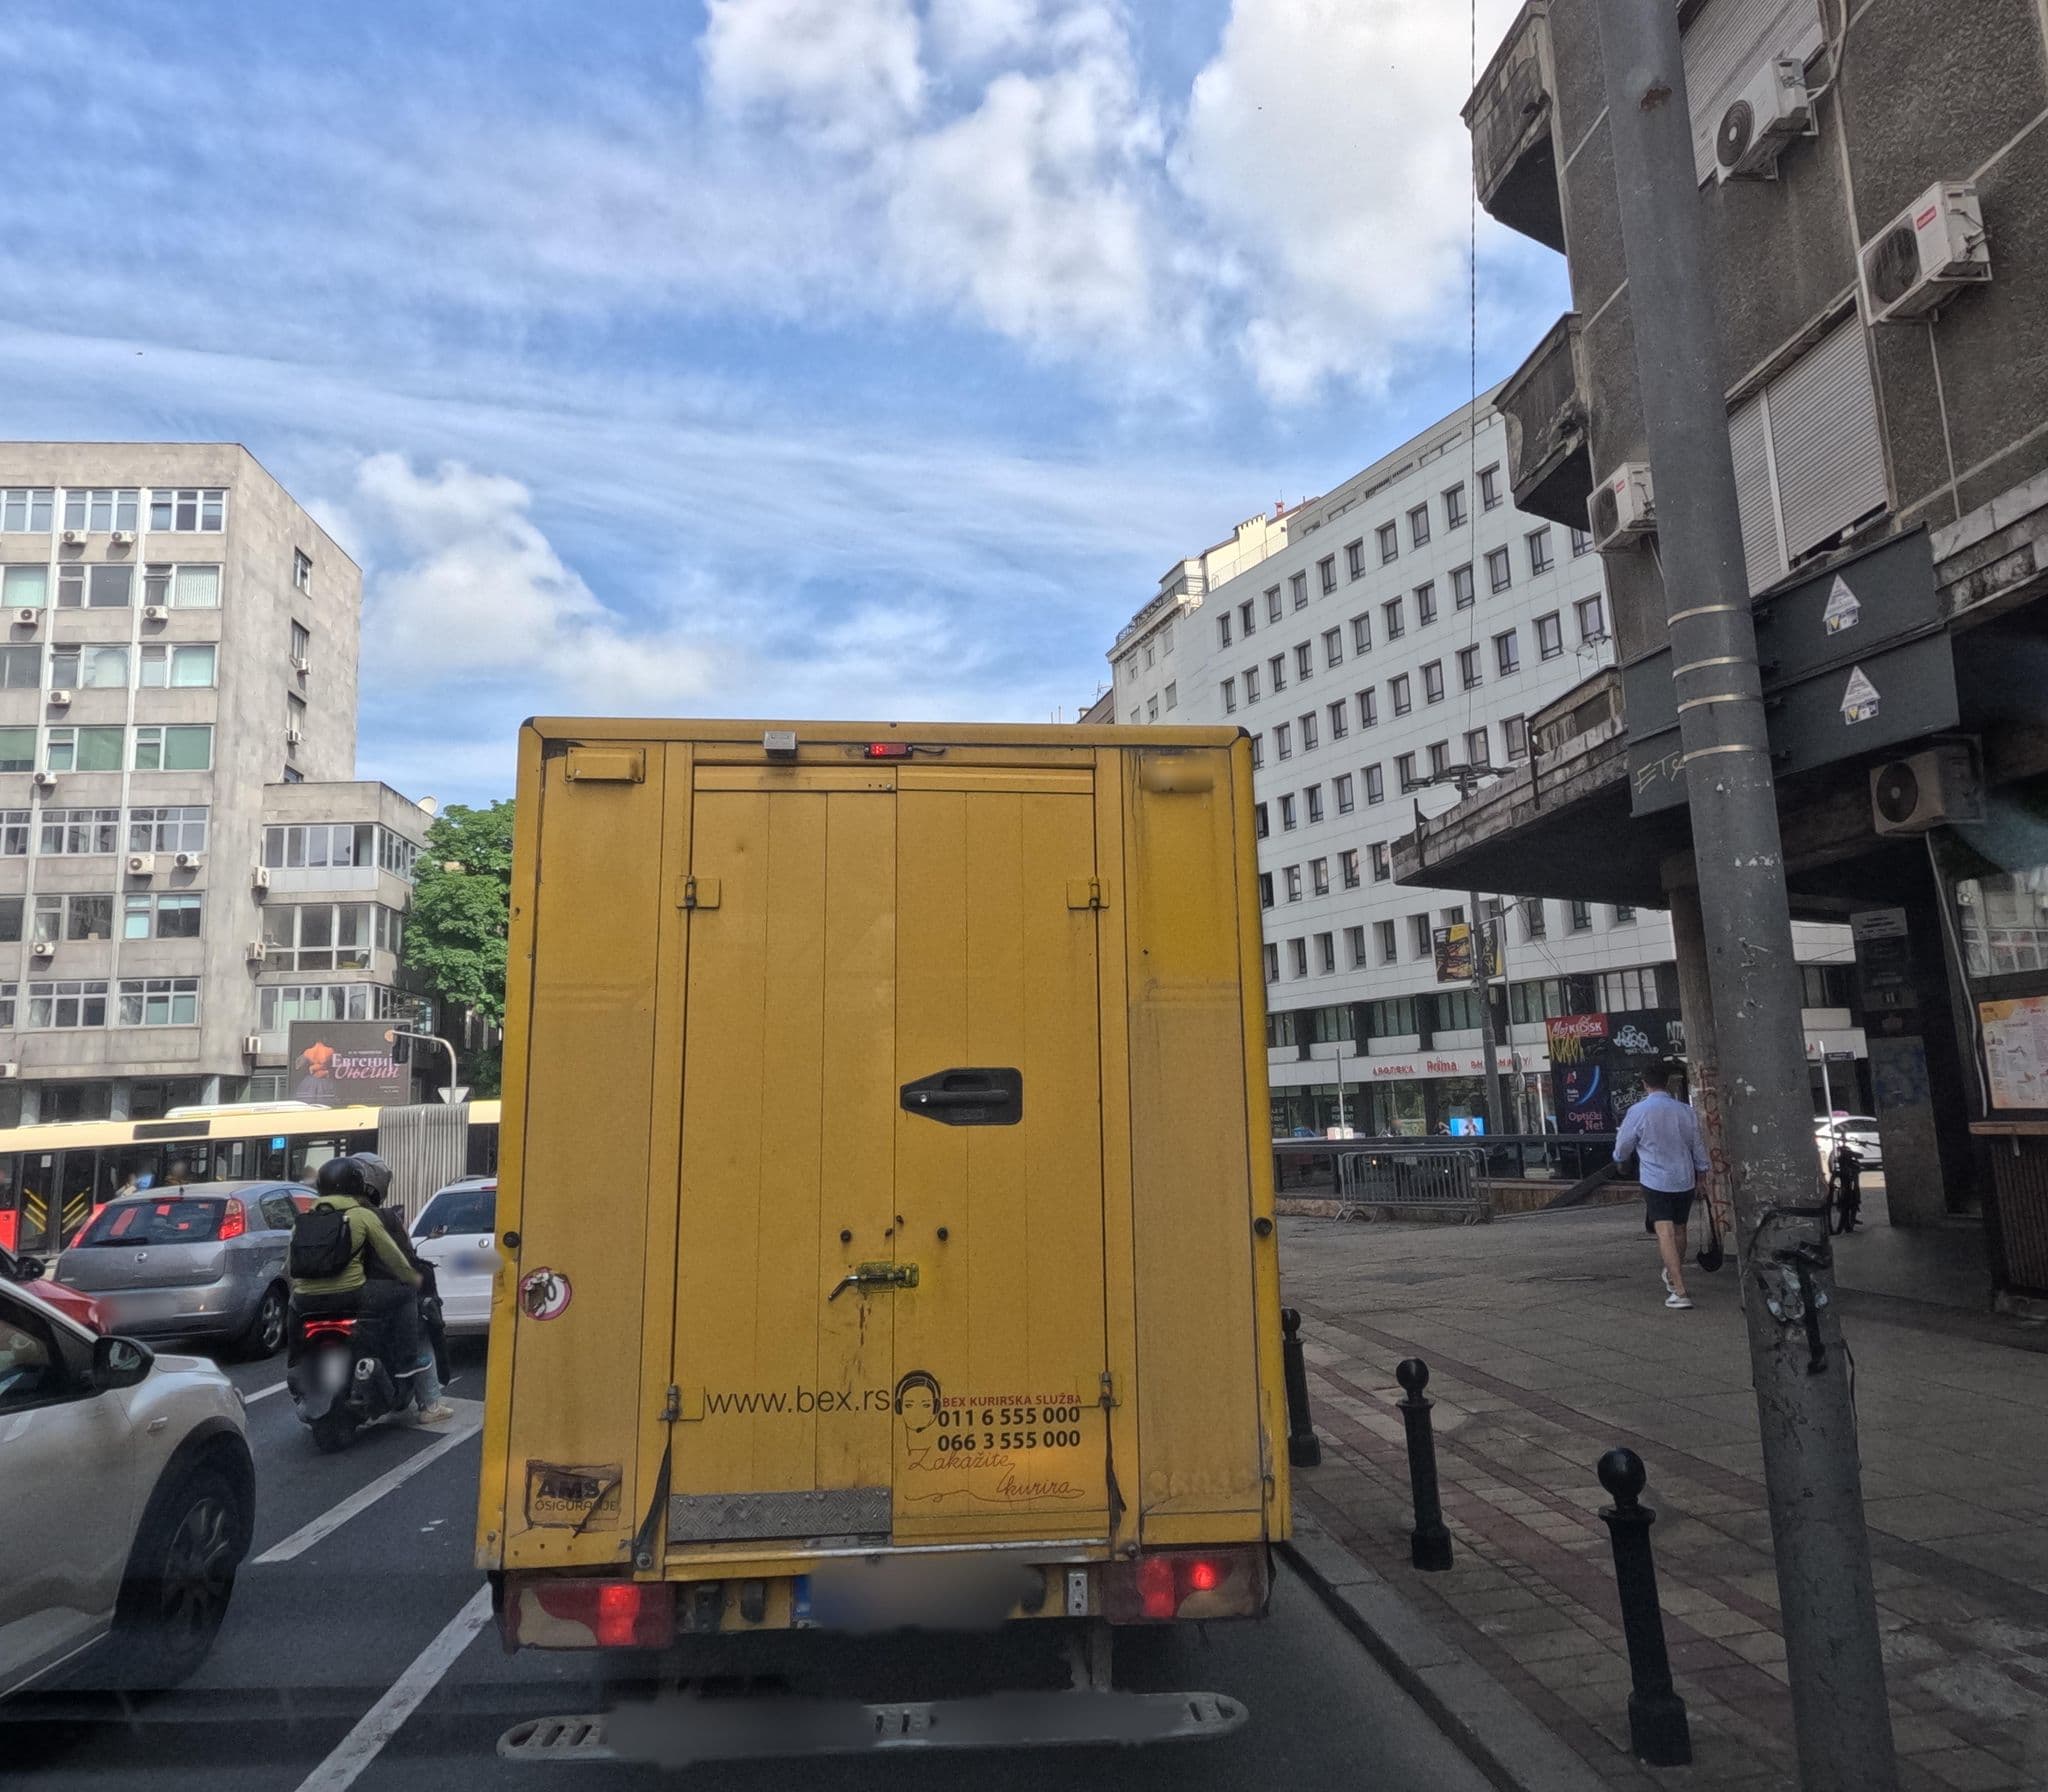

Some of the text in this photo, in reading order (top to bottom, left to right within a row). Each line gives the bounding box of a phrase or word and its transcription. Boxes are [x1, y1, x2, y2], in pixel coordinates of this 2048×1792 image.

[707, 1385, 890, 1414] www.bex.rs
[942, 1394, 1082, 1408] BEX KURIRSKA SLUŽBA
[938, 1406, 1081, 1427] 011 6 555 000
[938, 1430, 1081, 1452] 066 3 555 000
[908, 1449, 1014, 1471] Zakažite
[1000, 1475, 1080, 1497] kurira
